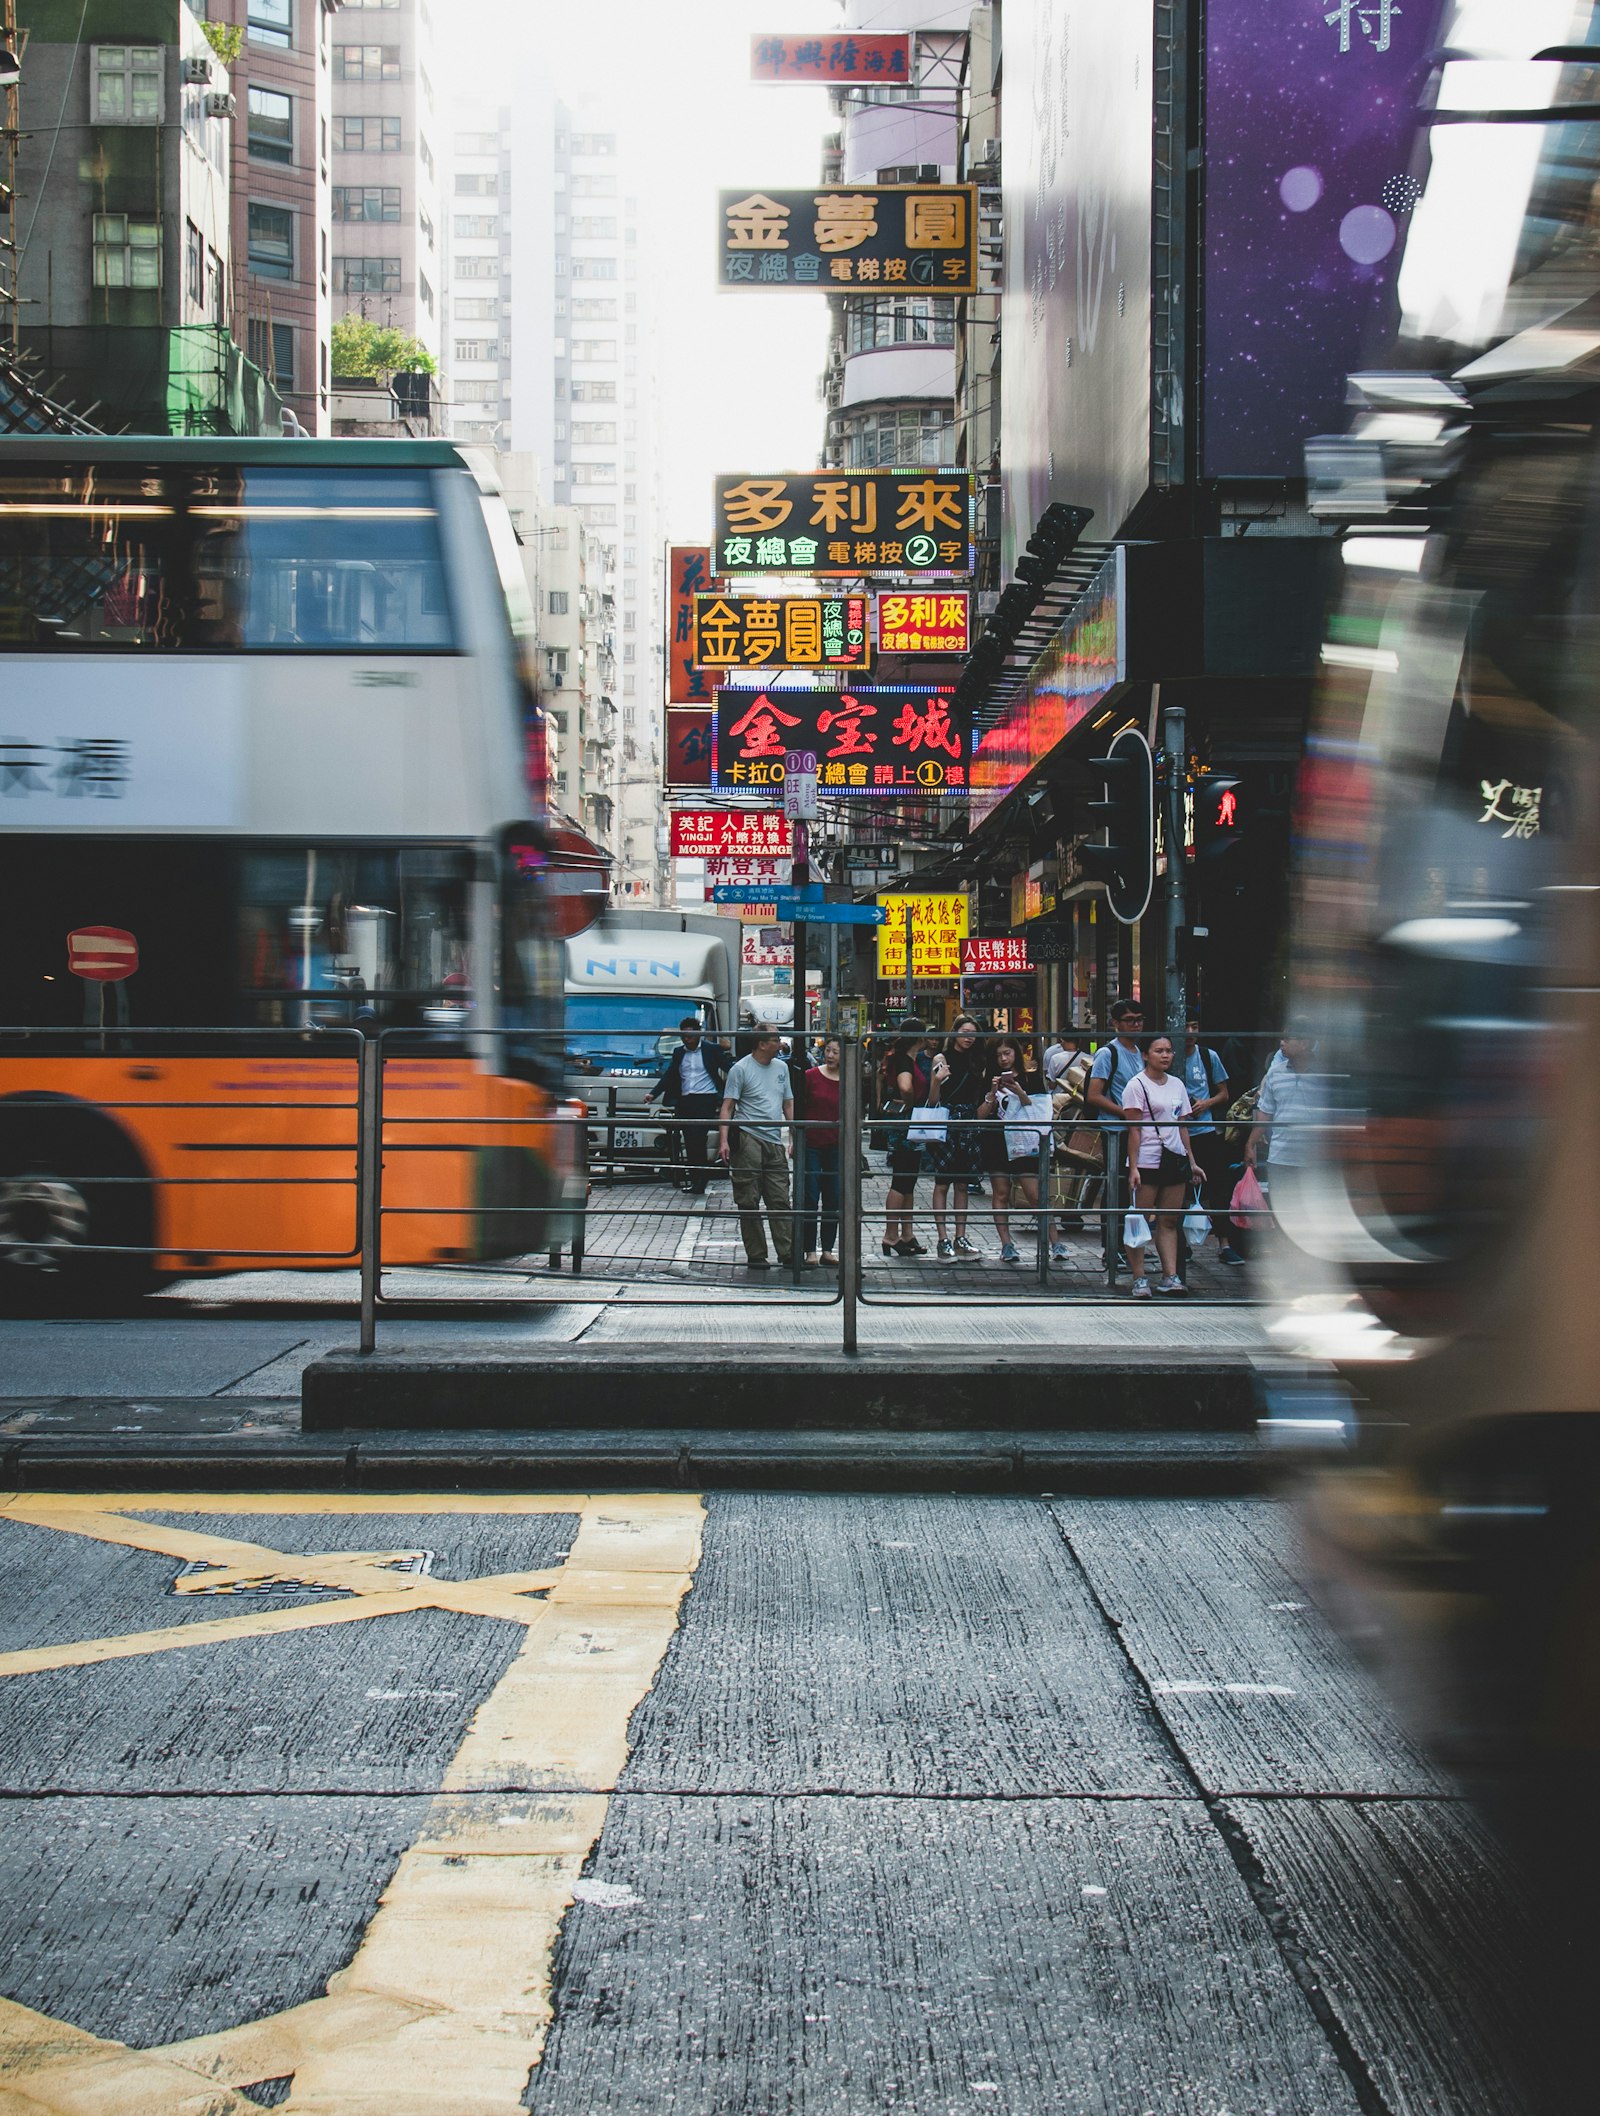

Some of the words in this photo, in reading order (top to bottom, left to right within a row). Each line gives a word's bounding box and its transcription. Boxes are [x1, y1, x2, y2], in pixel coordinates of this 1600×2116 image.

[726, 194, 966, 252] 金夢圓
[726, 253, 822, 281] 夜總會
[723, 479, 962, 534] 多利來
[723, 537, 818, 565] 夜總會
[882, 596, 965, 629] 多利來
[701, 600, 821, 664] 金夢圓
[823, 601, 843, 656] 夜總會
[882, 632, 922, 650] 夜總會
[787, 779, 800, 815] 旺角
[678, 816, 714, 831] 英記
[720, 814, 780, 831] 人民幣
[678, 845, 722, 854] MONEY
[680, 833, 713, 842] YINGJI
[720, 831, 780, 844] 外幣找換
[586, 959, 680, 977] NTN
[980, 960, 1006, 971] 2783
[610, 1068, 649, 1077] ISUZU
